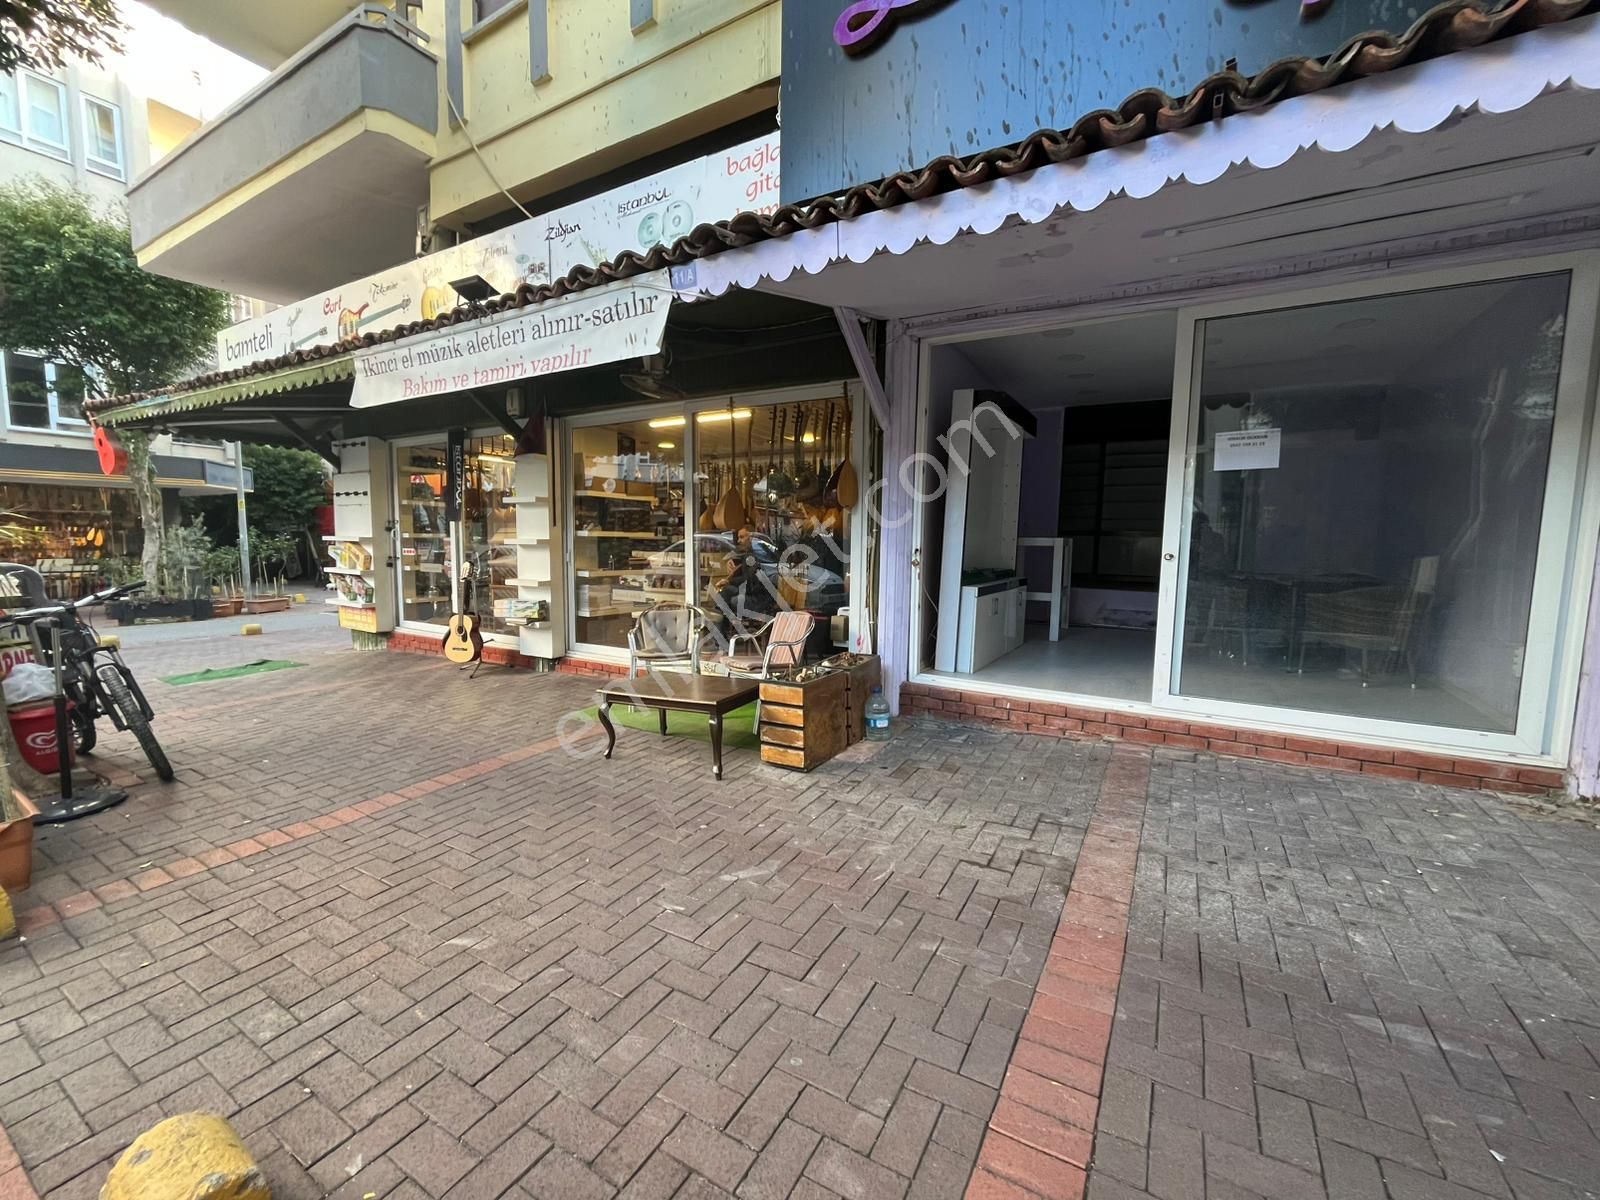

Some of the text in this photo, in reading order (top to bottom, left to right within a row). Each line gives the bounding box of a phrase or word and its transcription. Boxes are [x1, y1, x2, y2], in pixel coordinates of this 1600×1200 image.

[323, 295, 342, 316] Cort
[225, 323, 273, 361] bamteli
[401, 347, 415, 370] el
[417, 336, 464, 366] müzik
[466, 319, 525, 355] aletleri
[531, 291, 659, 340] alınır-satılır
[402, 344, 592, 397] Bakım ve tamiri yapılır
